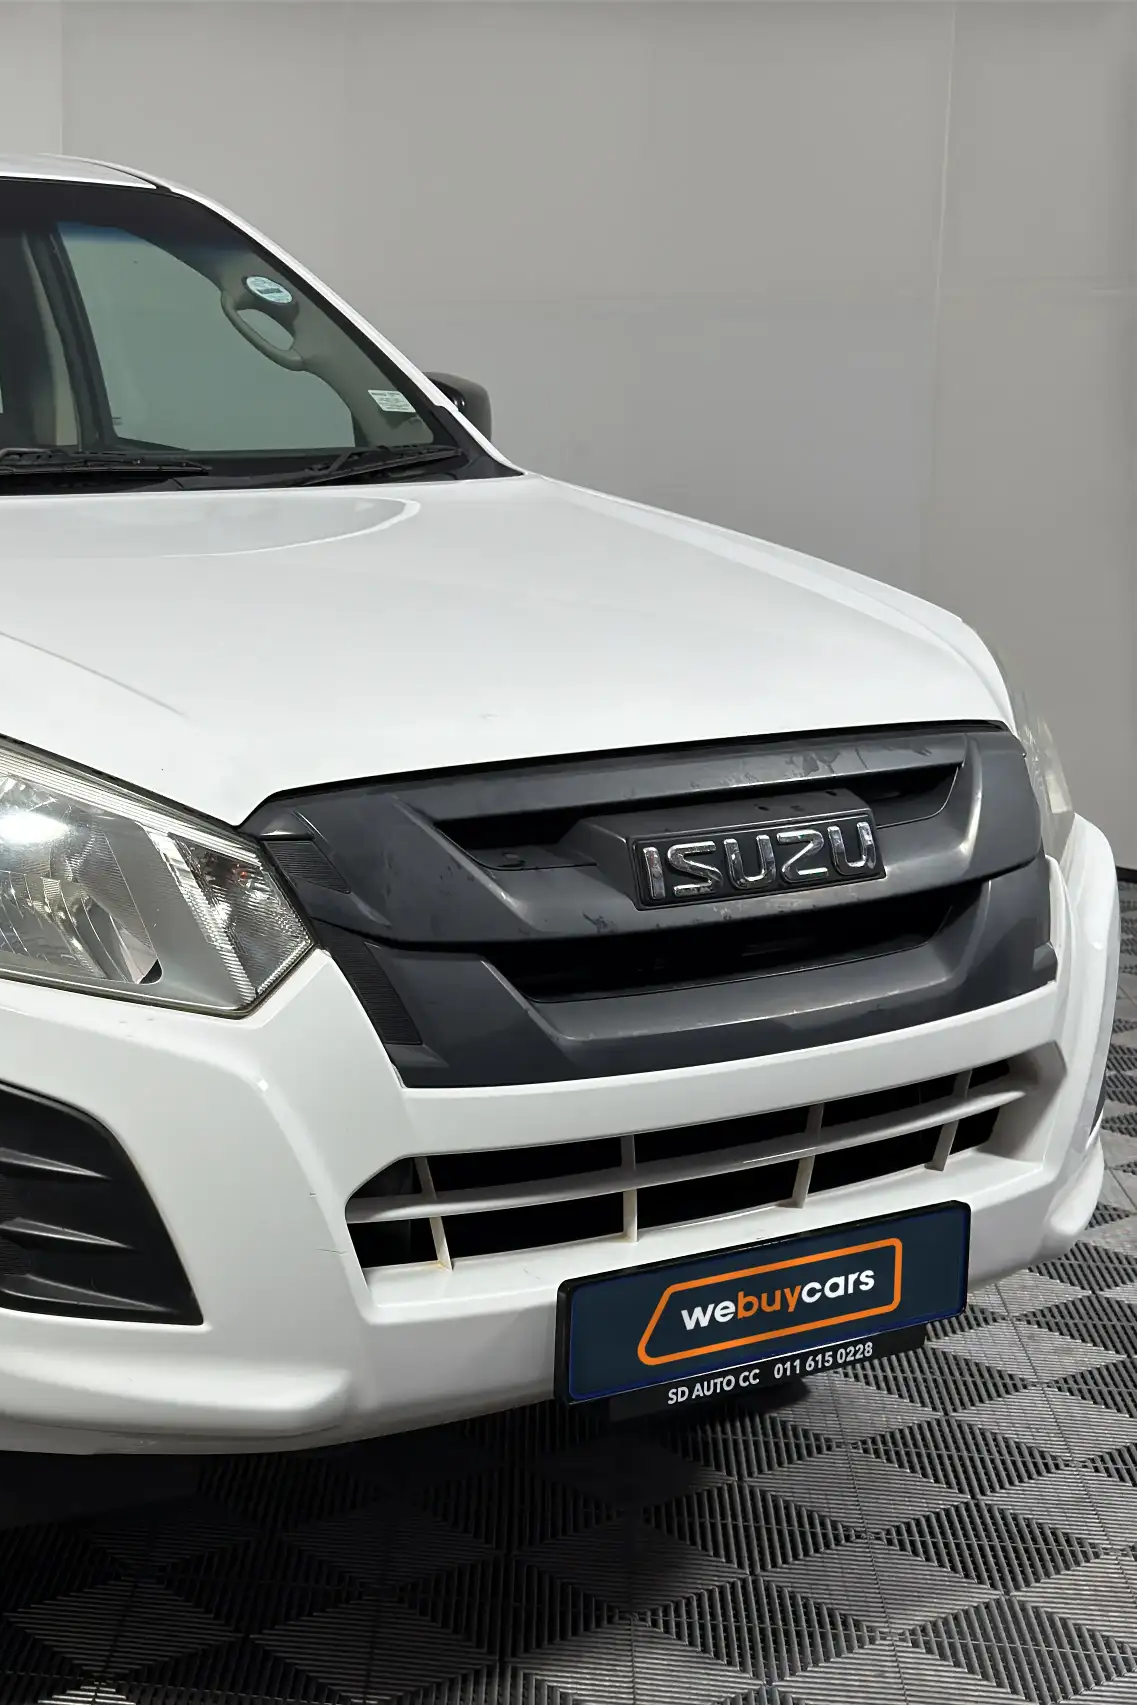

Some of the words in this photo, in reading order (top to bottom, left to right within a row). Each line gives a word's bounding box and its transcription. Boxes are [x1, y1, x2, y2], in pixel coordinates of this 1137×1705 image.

[642, 821, 876, 900] ISUZU
[681, 1269, 875, 1331] webuycars
[667, 1386, 689, 1405] SD
[691, 1375, 735, 1399] AUTO
[738, 1369, 760, 1387] CC
[774, 1360, 801, 1379] 011
[806, 1351, 833, 1371] 615
[836, 1342, 873, 1364] 0228
